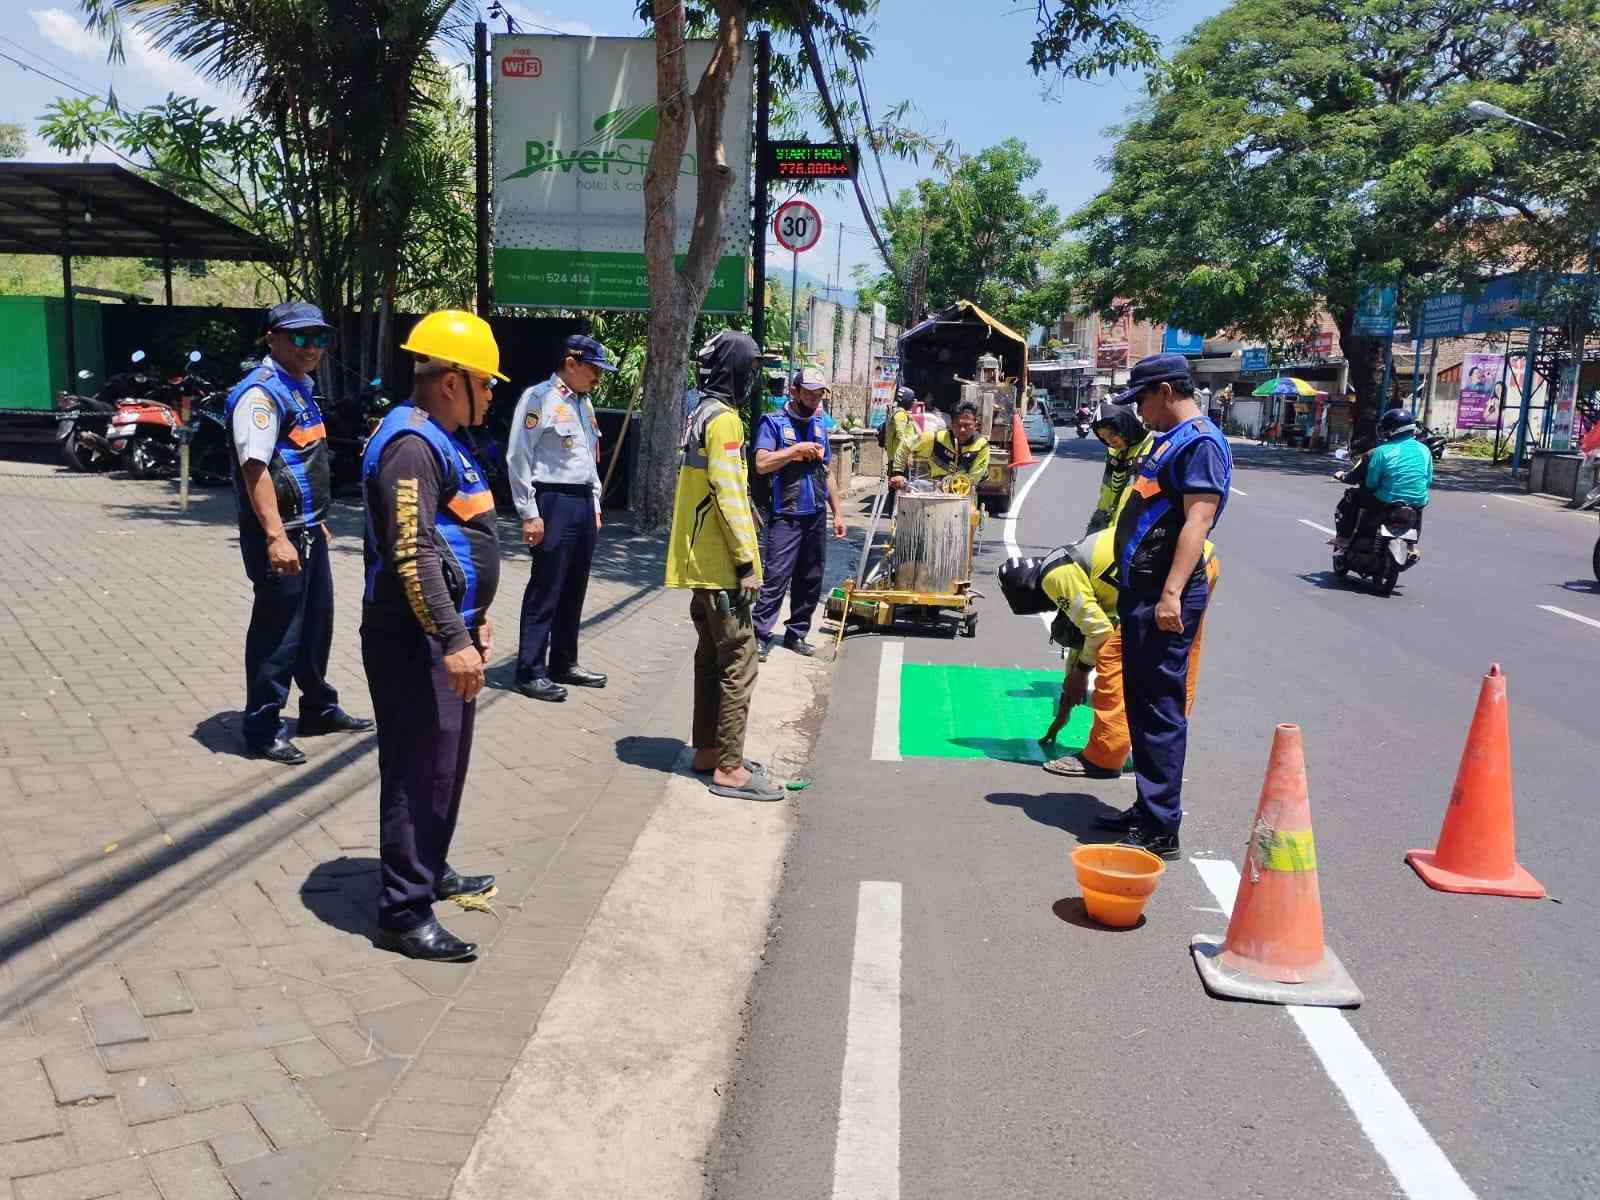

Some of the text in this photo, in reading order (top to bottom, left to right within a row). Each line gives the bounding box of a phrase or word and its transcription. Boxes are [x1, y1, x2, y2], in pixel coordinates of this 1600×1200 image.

[576, 176, 608, 191] hotel
[783, 216, 806, 238] 30
[546, 273, 568, 284] 524
[570, 273, 590, 284] 414
